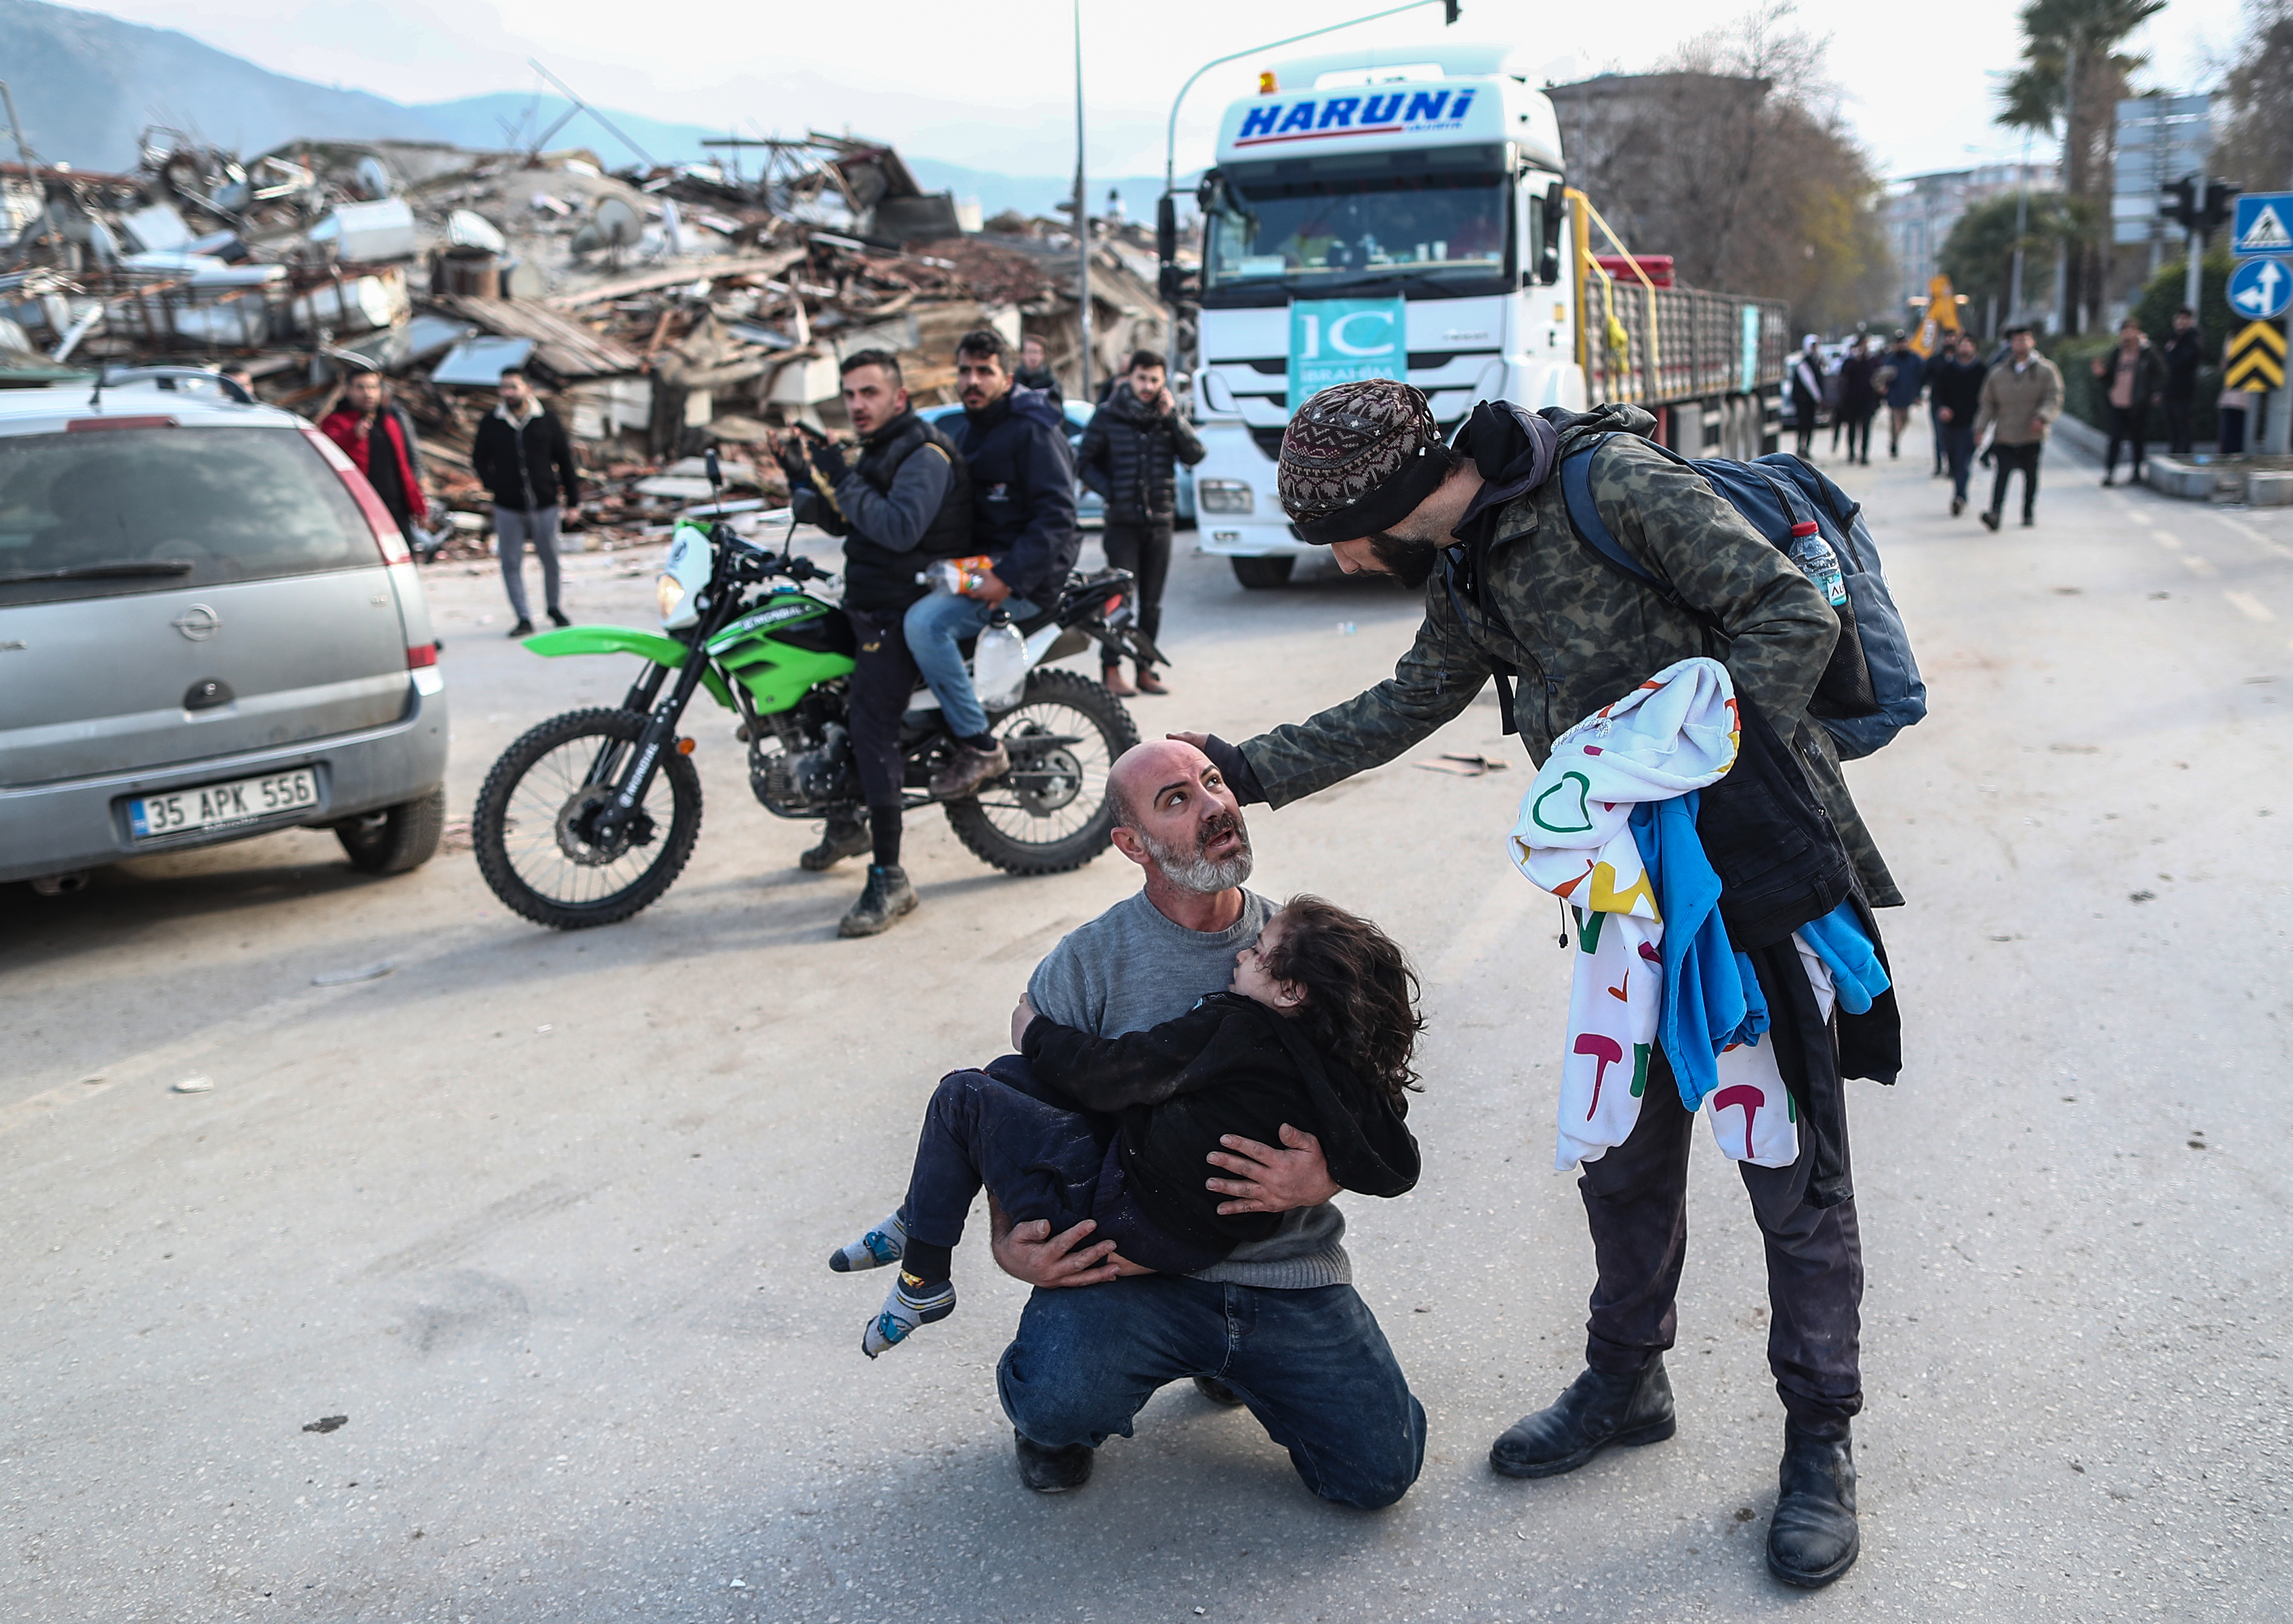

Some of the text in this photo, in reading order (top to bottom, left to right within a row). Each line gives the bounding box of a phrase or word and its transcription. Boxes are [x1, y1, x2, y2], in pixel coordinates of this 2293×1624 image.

[625, 742, 660, 796] MONDIAL
[149, 797, 185, 828] 35
[200, 785, 248, 819] APK
[262, 774, 310, 808] 556
